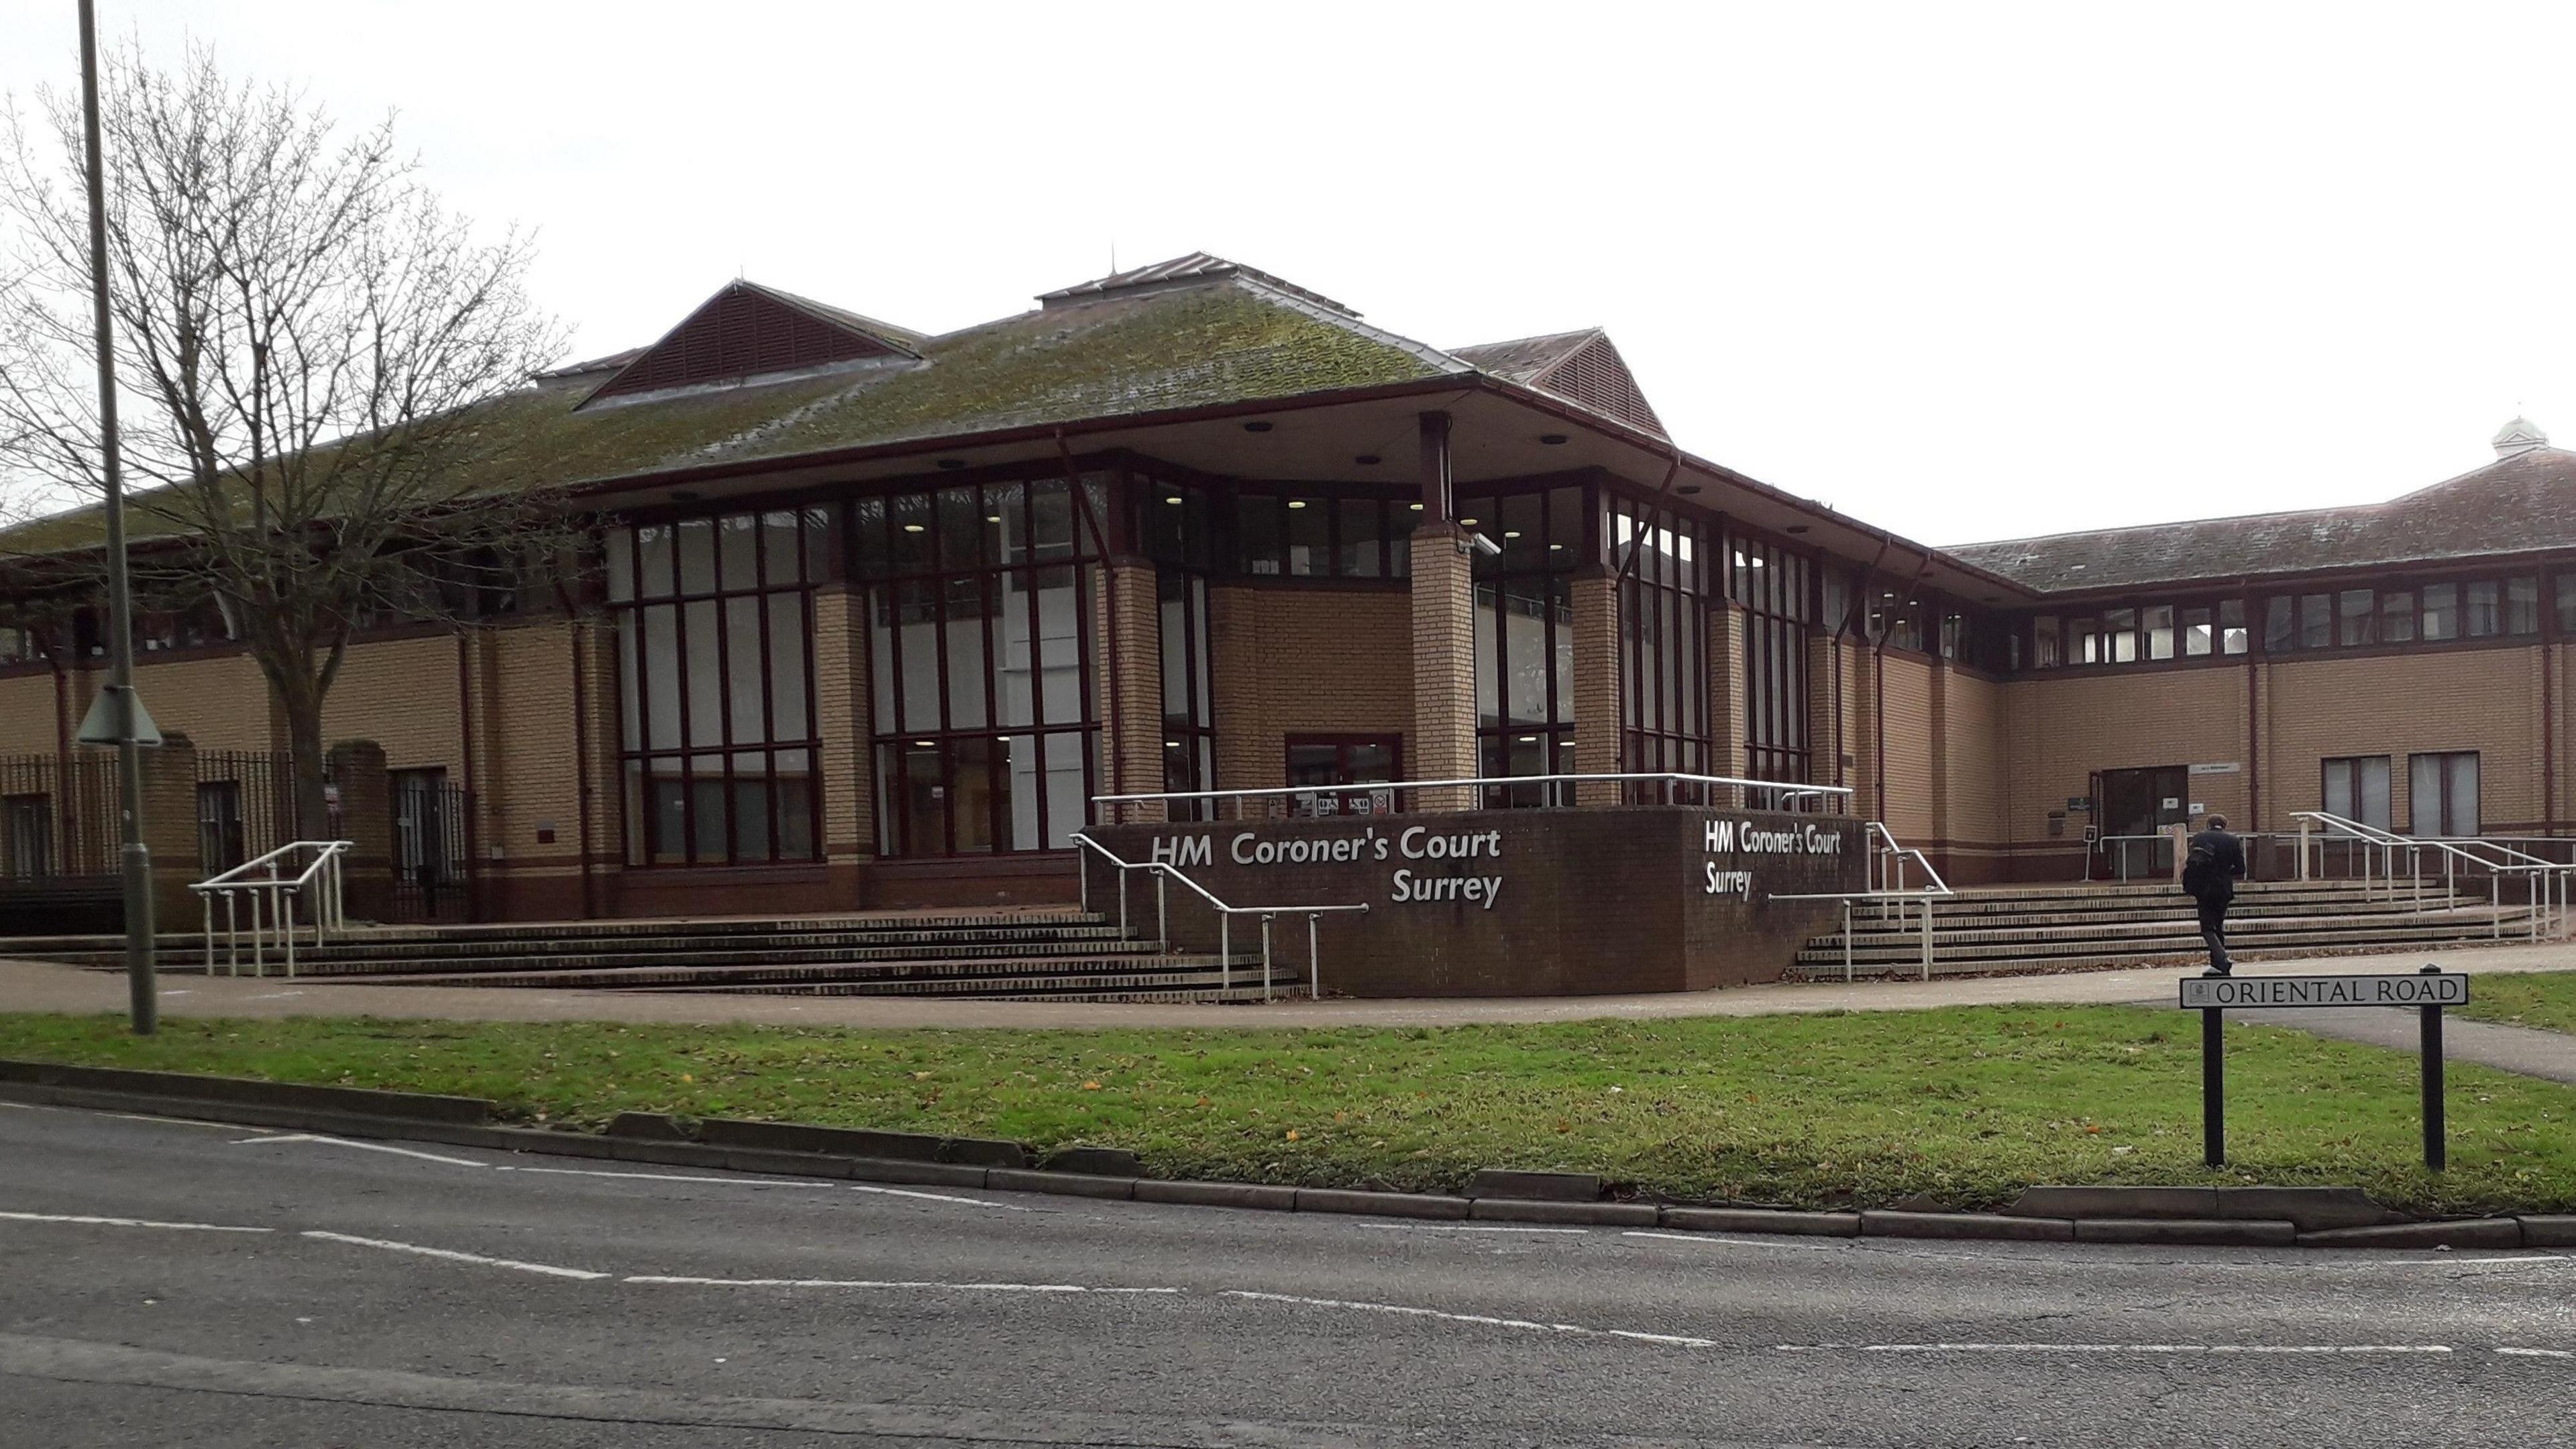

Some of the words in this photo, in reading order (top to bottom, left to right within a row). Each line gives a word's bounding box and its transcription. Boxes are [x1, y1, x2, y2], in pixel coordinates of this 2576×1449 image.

[1152, 835, 1212, 866] HM
[1231, 827, 1388, 865] Coroner's
[1400, 826, 1501, 859] Court
[1705, 820, 1733, 853] HM
[1741, 821, 1803, 853] Coroner's
[1805, 824, 1841, 854] Court
[1392, 869, 1503, 909] Surrey
[1707, 861, 1752, 902] Surrey
[2216, 980, 2365, 1004] ORIENTAL
[2377, 979, 2458, 1001] ROAD
